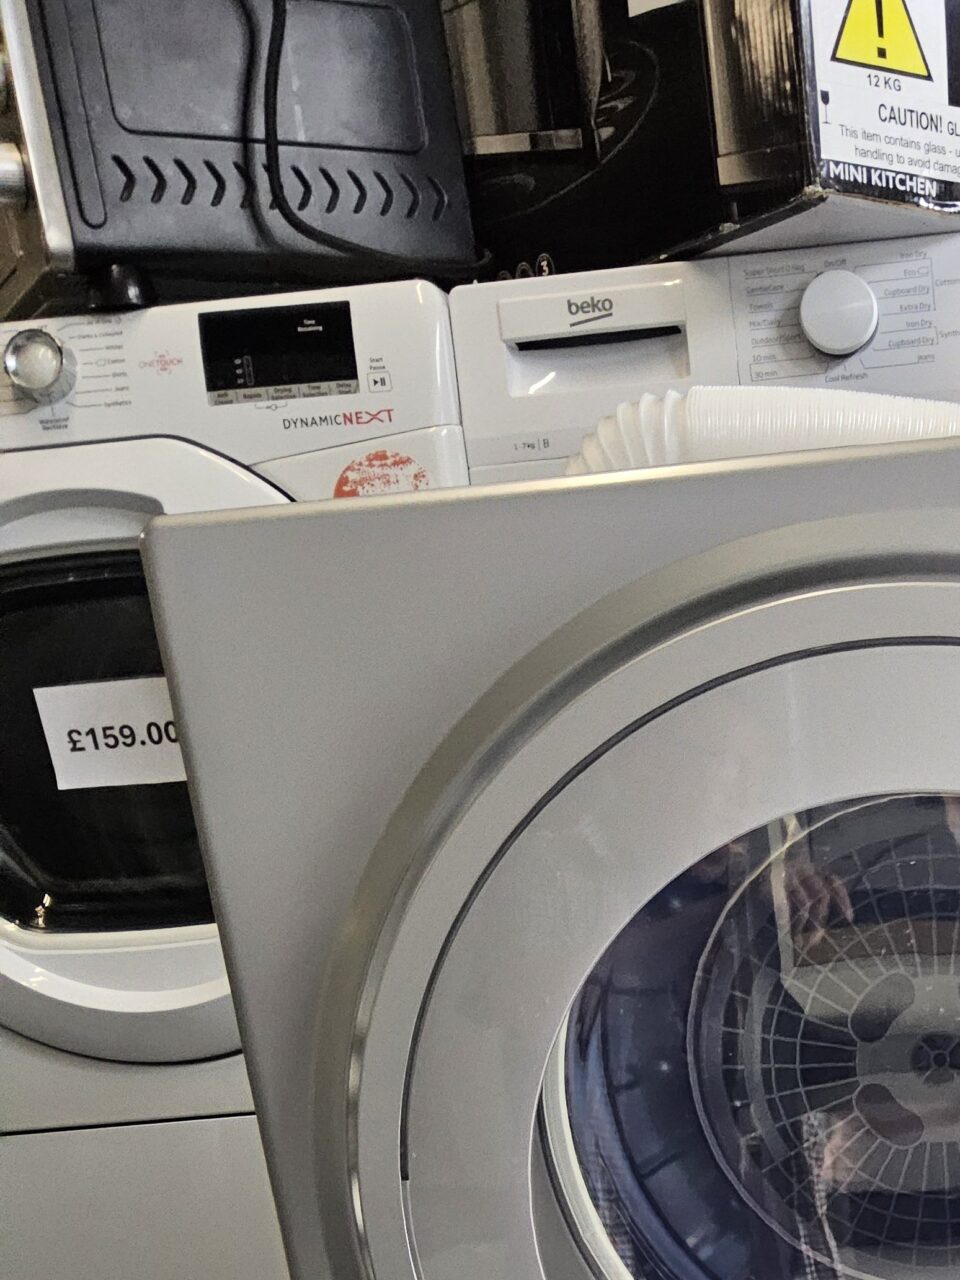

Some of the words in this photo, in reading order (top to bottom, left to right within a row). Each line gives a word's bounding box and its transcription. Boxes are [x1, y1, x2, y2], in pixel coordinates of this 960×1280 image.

[866, 73, 880, 87] 12
[884, 76, 902, 92] KG
[878, 103, 943, 134] CAUTION!
[839, 124, 859, 140] This
[861, 127, 882, 144] item
[884, 132, 921, 152] contains
[923, 140, 947, 157] glass
[854, 145, 894, 166] handling
[896, 153, 905, 165] to
[907, 153, 931, 171] avoid
[829, 160, 868, 185] MINI
[871, 168, 938, 198] KITCHEN
[567, 296, 613, 316] beko
[282, 408, 394, 429] DYNAMICNEXT
[67, 720, 179, 752] £159.00
